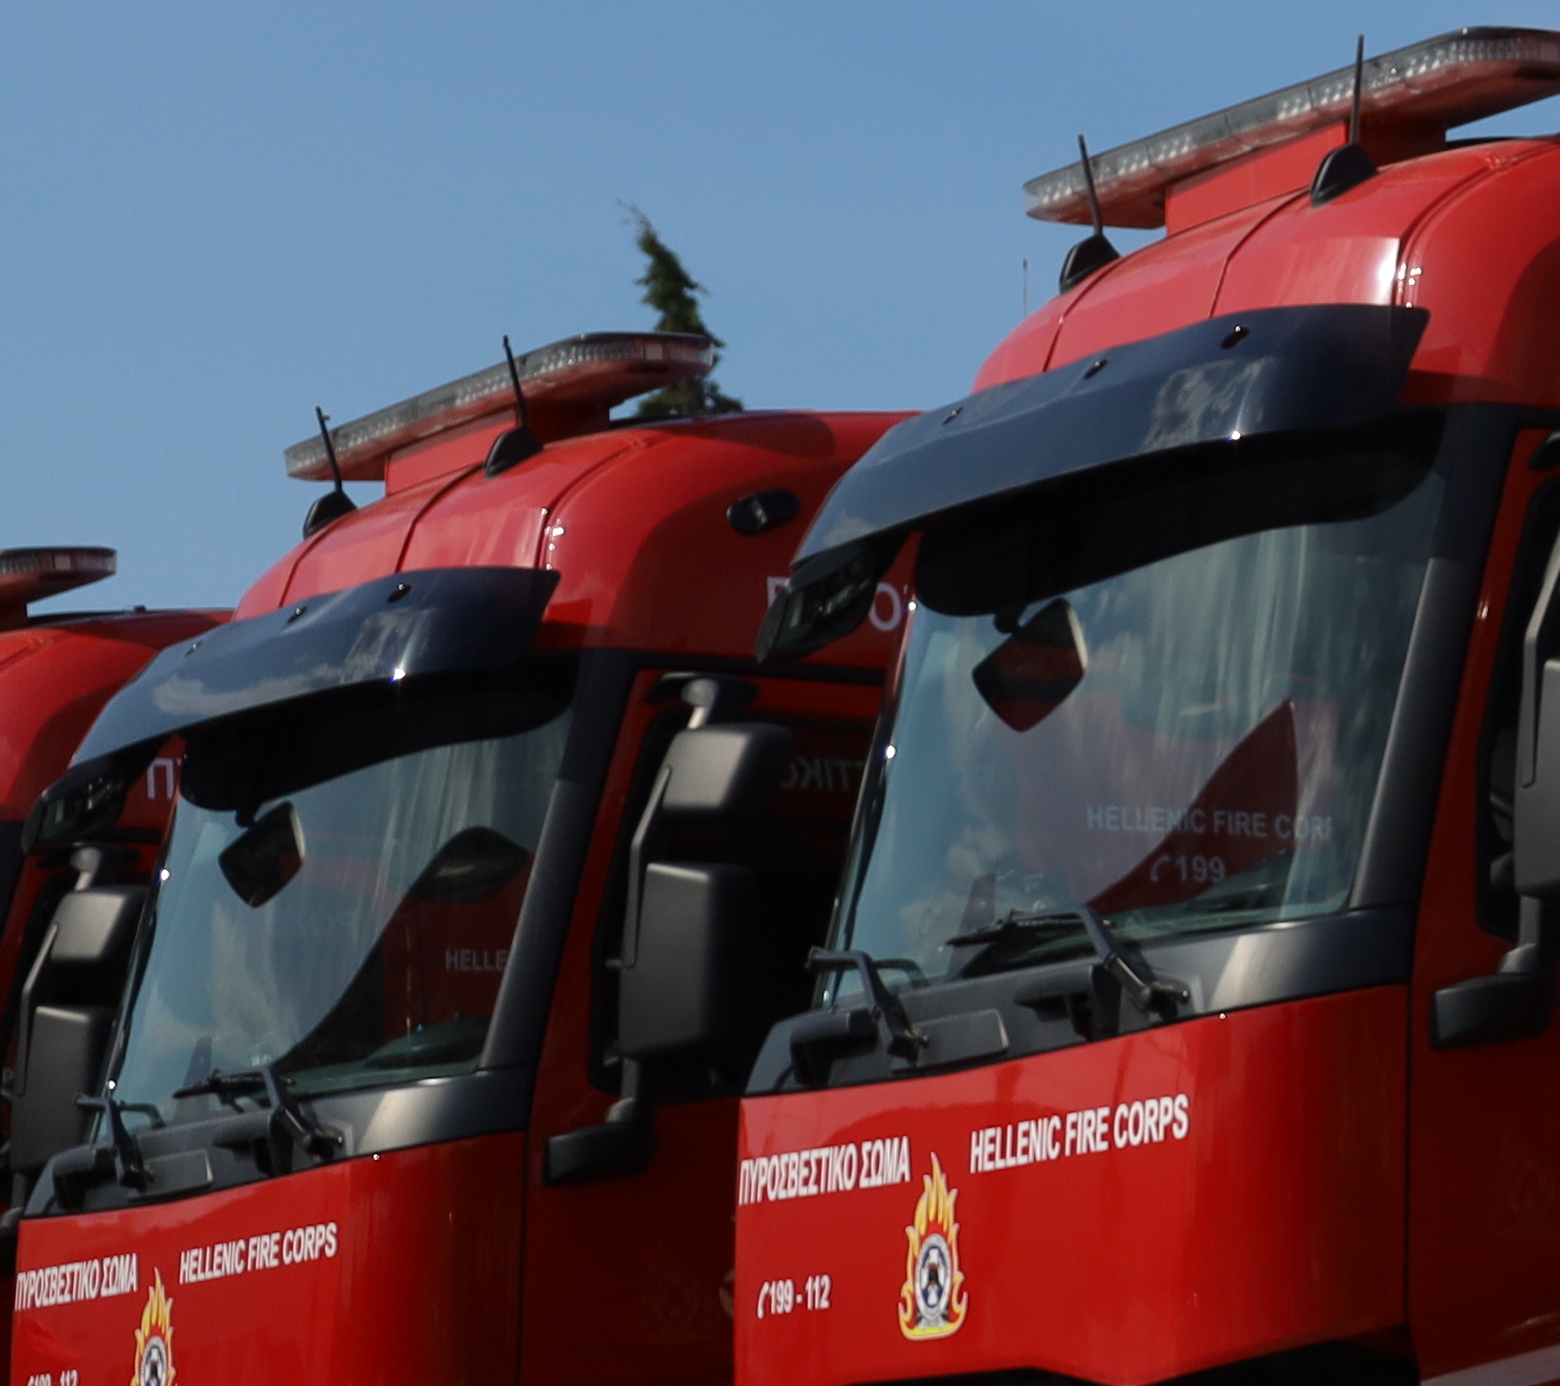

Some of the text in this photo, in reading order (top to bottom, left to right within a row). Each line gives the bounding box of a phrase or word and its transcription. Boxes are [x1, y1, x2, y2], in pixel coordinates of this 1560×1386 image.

[1212, 809, 1268, 838] FIRE
[970, 1093, 1190, 1175] HELLENIC FIRE CORPS
[739, 1135, 910, 1206] ΠΥΡΟΣΒΕΣΤΙΚΟ ΣΩΜΑ
[14, 1252, 138, 1312] ΠΥΡΟΣΒΕΣΤΙΚΟ ΣΩΜΑ
[179, 1221, 338, 1285] HELLENIC FIRE CORPS
[768, 1280, 794, 1316] 199
[804, 1274, 832, 1311] 112
